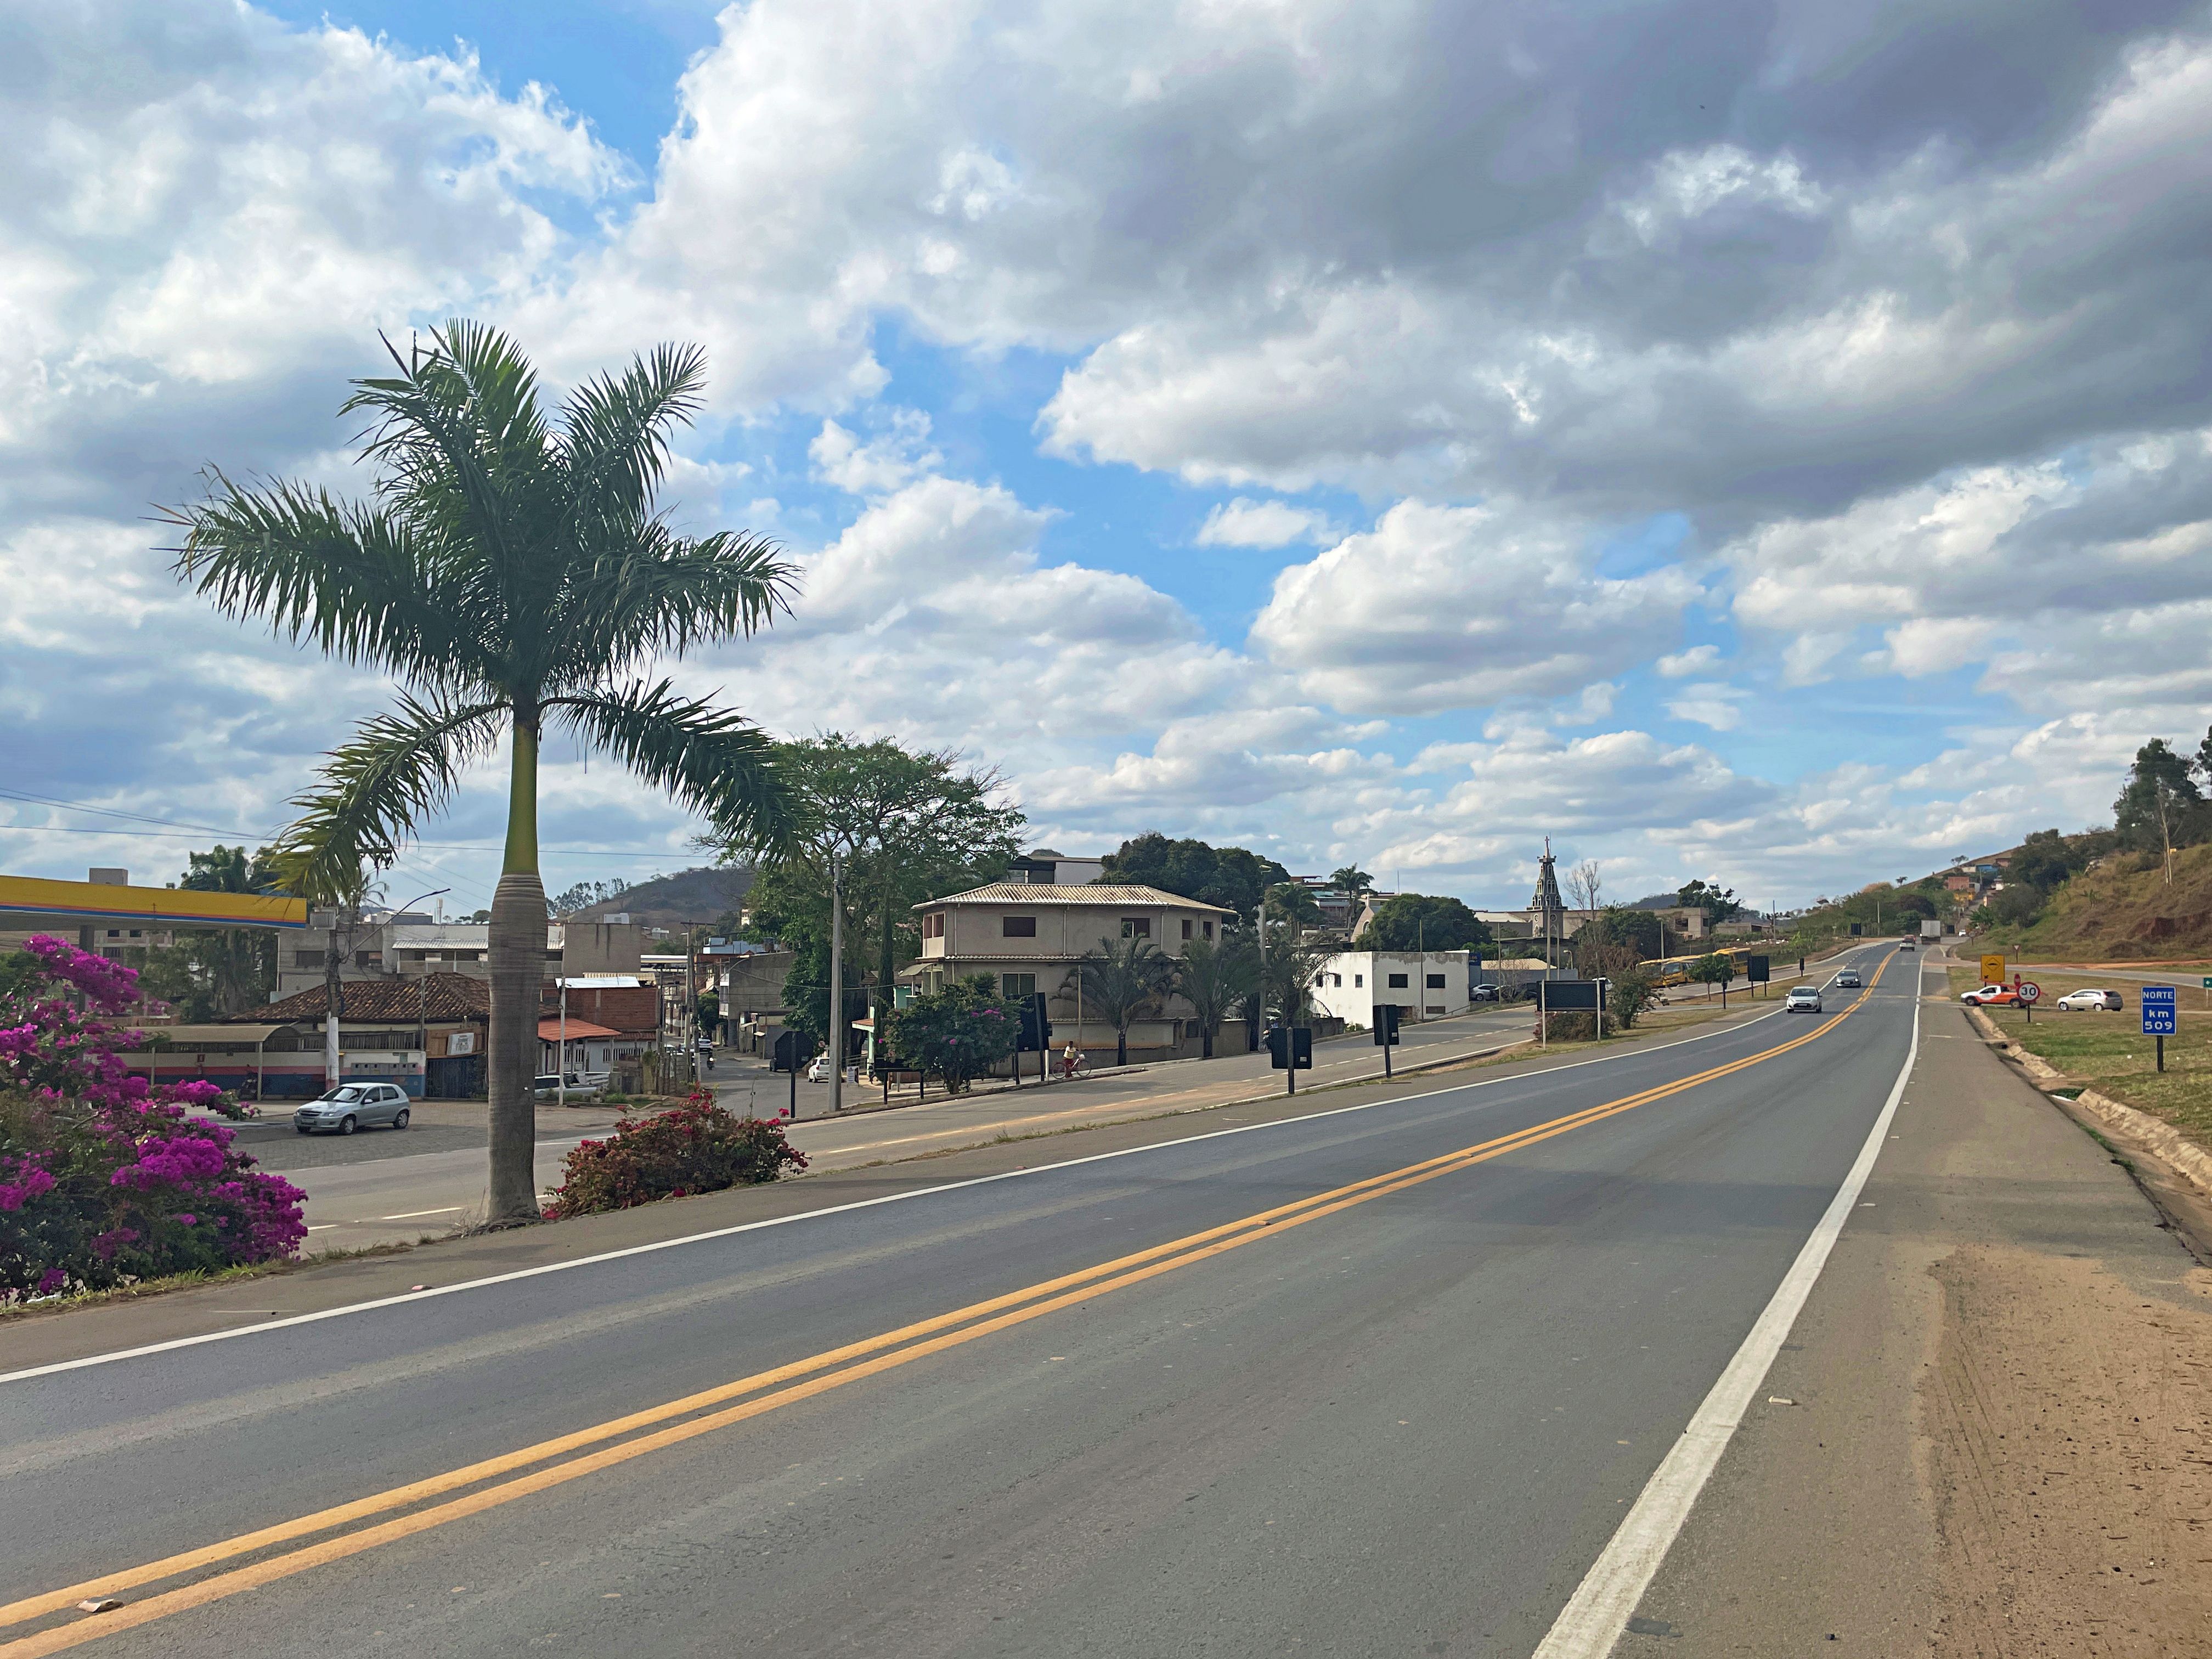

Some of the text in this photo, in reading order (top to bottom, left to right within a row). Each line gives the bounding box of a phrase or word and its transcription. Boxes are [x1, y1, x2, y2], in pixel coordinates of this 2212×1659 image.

[2021, 987, 2036, 996] 30
[2143, 991, 2174, 999] NORTE
[2149, 1009, 2169, 1018] km
[2145, 1021, 2172, 1030] 509
